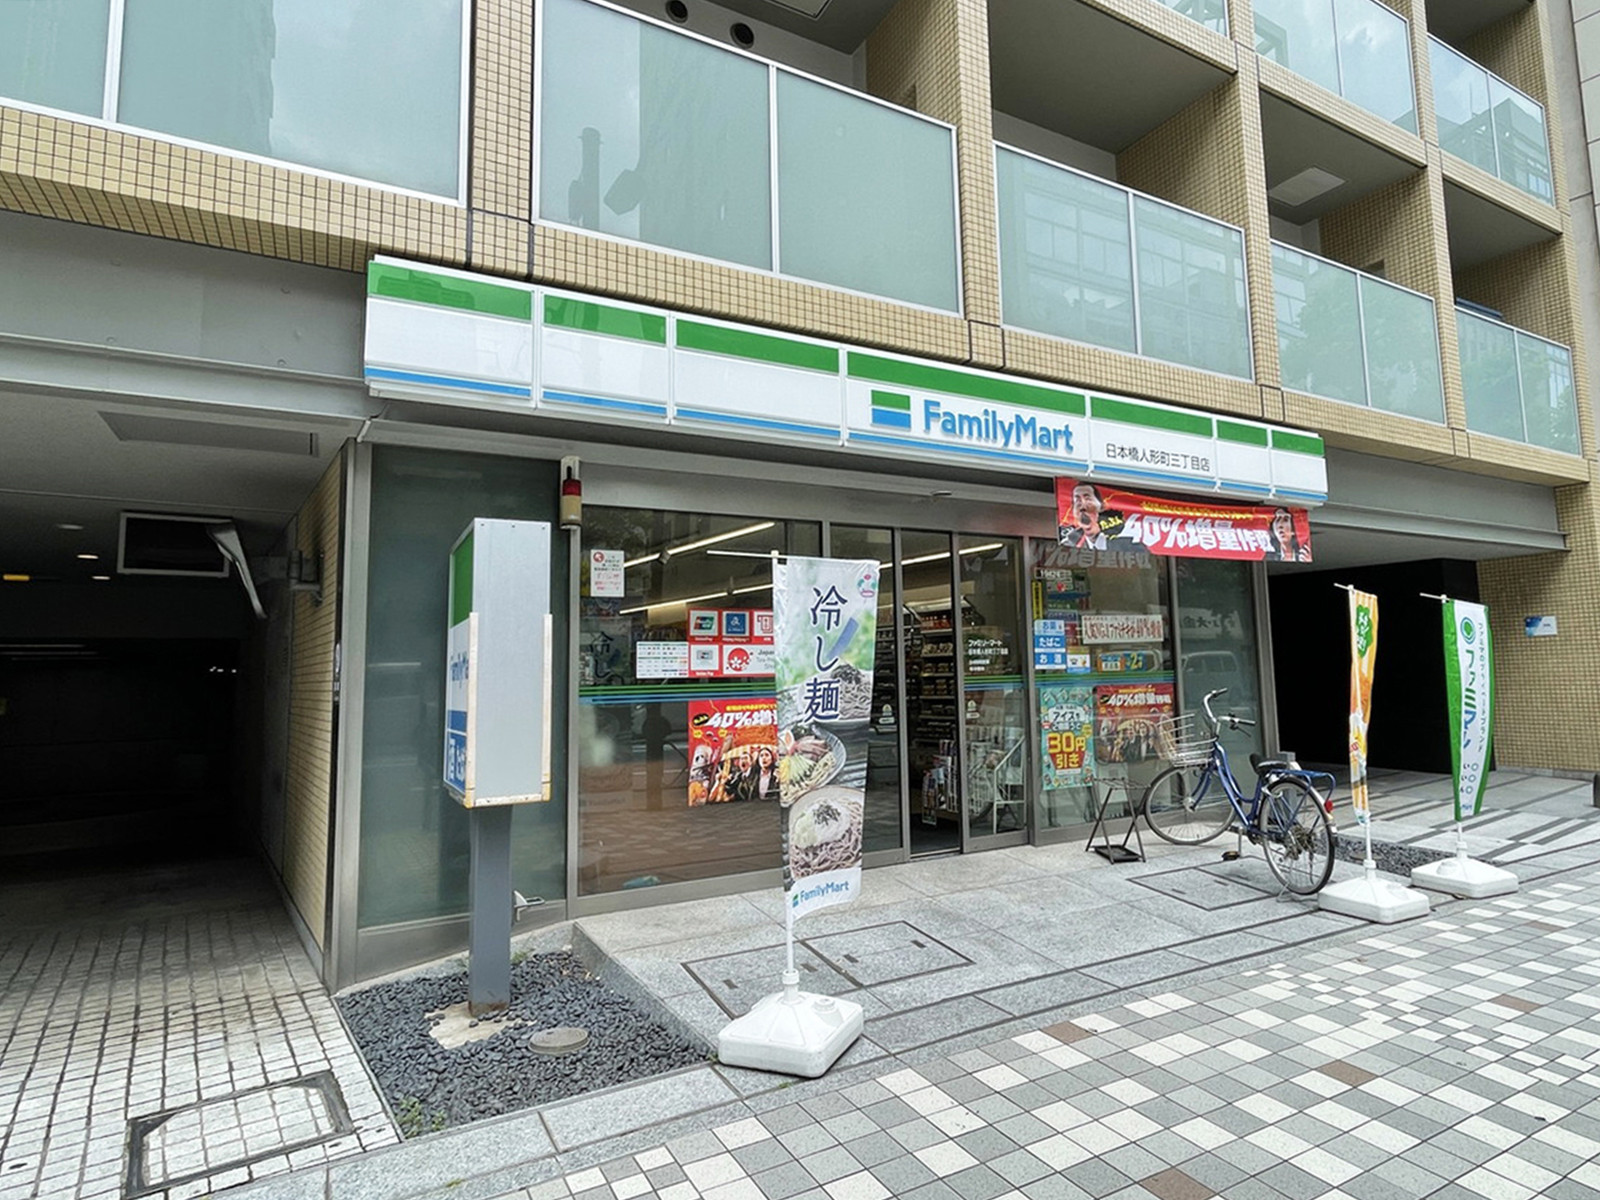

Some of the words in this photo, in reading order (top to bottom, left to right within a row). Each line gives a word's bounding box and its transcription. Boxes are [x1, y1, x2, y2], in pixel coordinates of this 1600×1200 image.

[923, 398, 1074, 454] FamilyMart
[1106, 442, 1211, 472] 日本橋人形町三丁目店
[1039, 637, 1061, 647] たばこ
[803, 584, 848, 723] 冷し麺
[1047, 731, 1087, 753] 30円
[1055, 753, 1080, 769] 引き
[800, 880, 850, 902] FamilyMart
